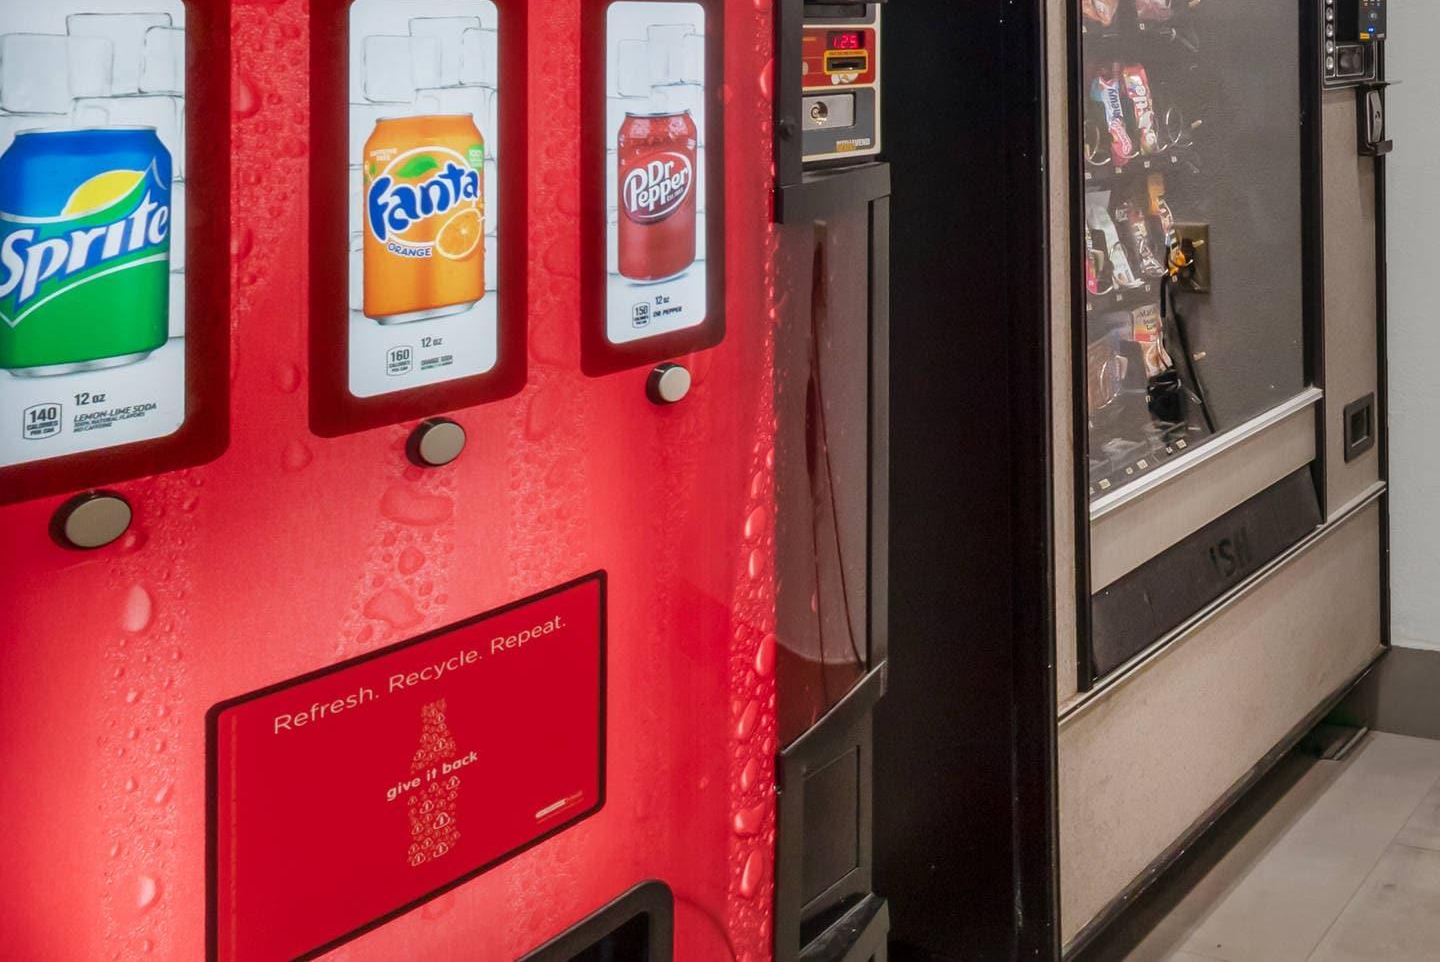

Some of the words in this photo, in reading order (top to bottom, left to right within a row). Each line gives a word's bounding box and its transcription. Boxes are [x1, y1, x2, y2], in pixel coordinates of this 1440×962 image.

[647, 161, 674, 188] Dr
[630, 168, 688, 213] Pepper
[367, 163, 478, 242] Fanta
[0, 190, 168, 305] Sprite
[388, 242, 431, 257] ORANGE
[635, 305, 648, 316] 150
[421, 337, 432, 348] 12
[391, 349, 410, 363] 160
[74, 392, 90, 406] 12
[92, 393, 106, 404] oz
[30, 407, 57, 423] 140
[74, 406, 131, 423] LEMON-LIME
[133, 403, 157, 413] SODA
[274, 687, 379, 735] Refresh.
[388, 650, 482, 693] Recycle.
[490, 615, 566, 655] Repeat.
[387, 776, 421, 802] give
[426, 768, 437, 782] it
[442, 751, 478, 775] back
